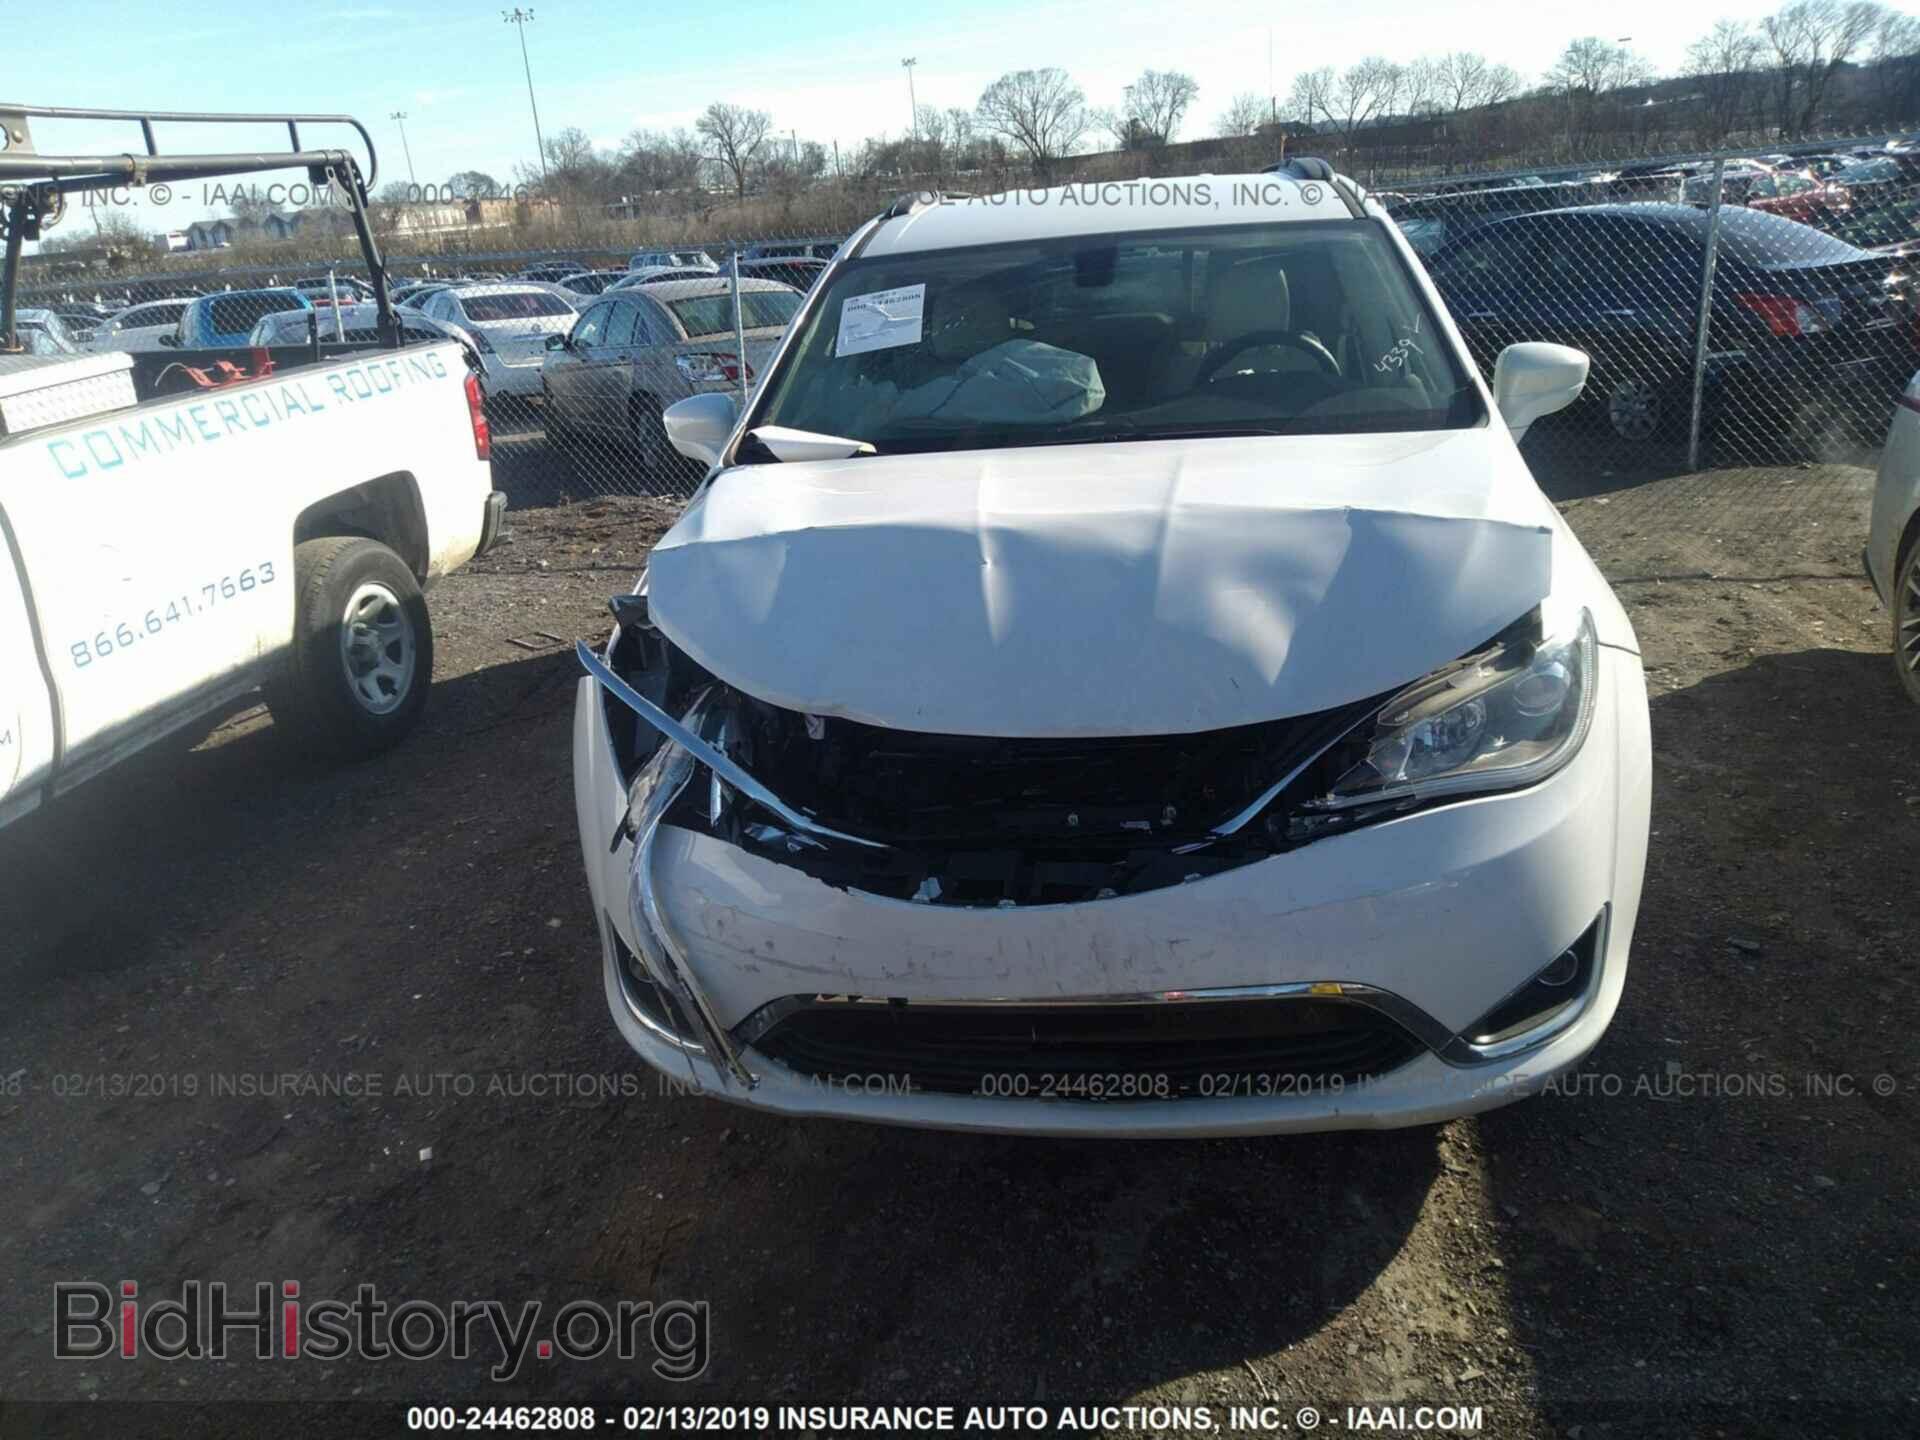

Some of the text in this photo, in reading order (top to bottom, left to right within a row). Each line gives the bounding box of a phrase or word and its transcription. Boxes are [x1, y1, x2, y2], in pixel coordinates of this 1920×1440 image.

[47, 352, 448, 480] COMMERCIAL ROOFING
[70, 561, 277, 669] 866.641.7663
